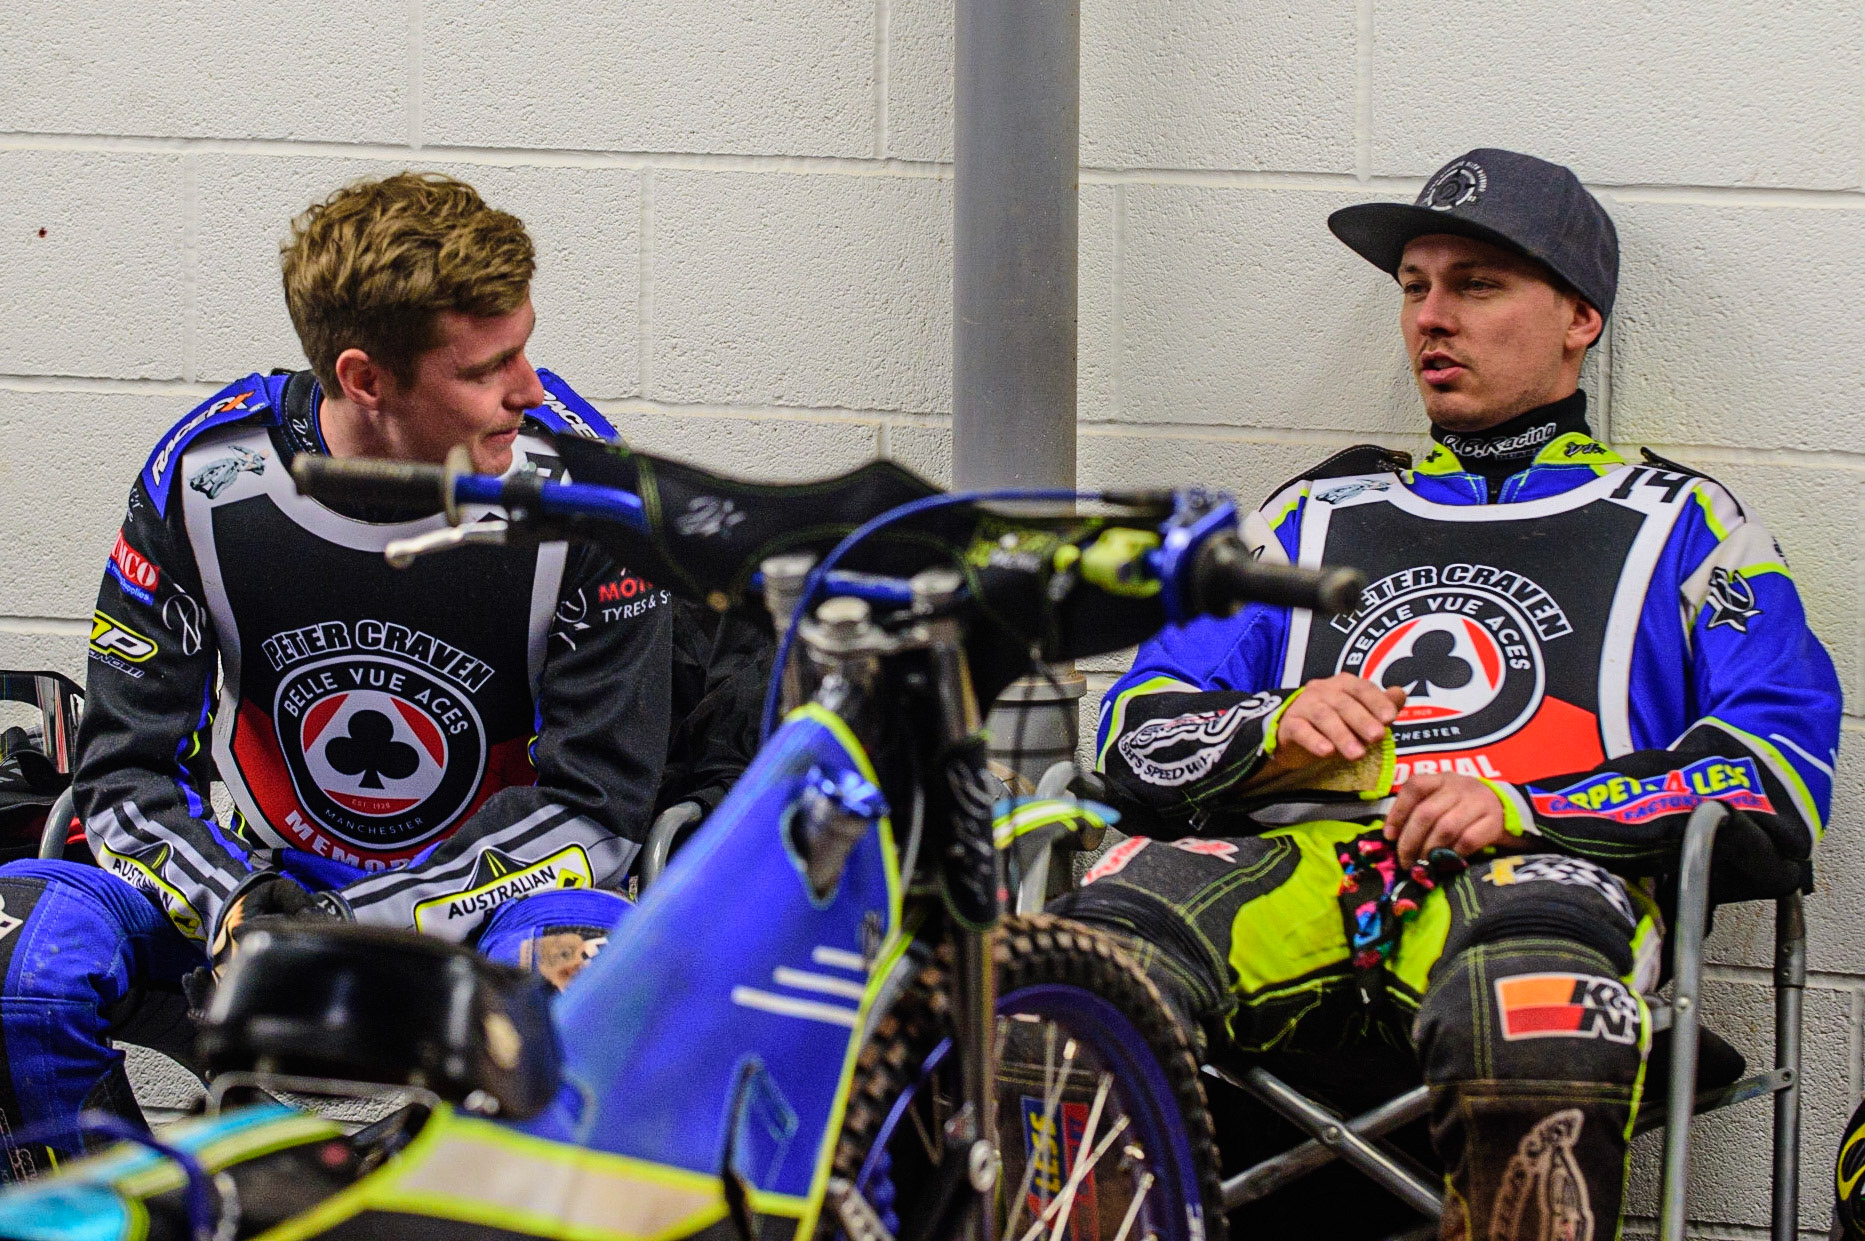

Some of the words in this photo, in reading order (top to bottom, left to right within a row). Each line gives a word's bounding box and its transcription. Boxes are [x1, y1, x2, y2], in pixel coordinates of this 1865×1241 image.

[1610, 467, 1694, 503] 14
[602, 599, 647, 622] TYRES
[648, 594, 656, 609] &
[1441, 563, 1574, 641] CRAVEN
[262, 620, 352, 672] PETER
[355, 619, 495, 693] CRAVEN
[1346, 604, 1414, 666] BELLE
[1426, 596, 1484, 615] VUE
[1484, 615, 1531, 670] ACES
[283, 671, 338, 718] BELLE
[349, 667, 406, 692] VUE
[414, 688, 469, 735] ACES
[1692, 763, 1751, 795] LESS
[325, 808, 424, 836] MANCHESTER
[447, 864, 557, 920] AUSTRALIAN
